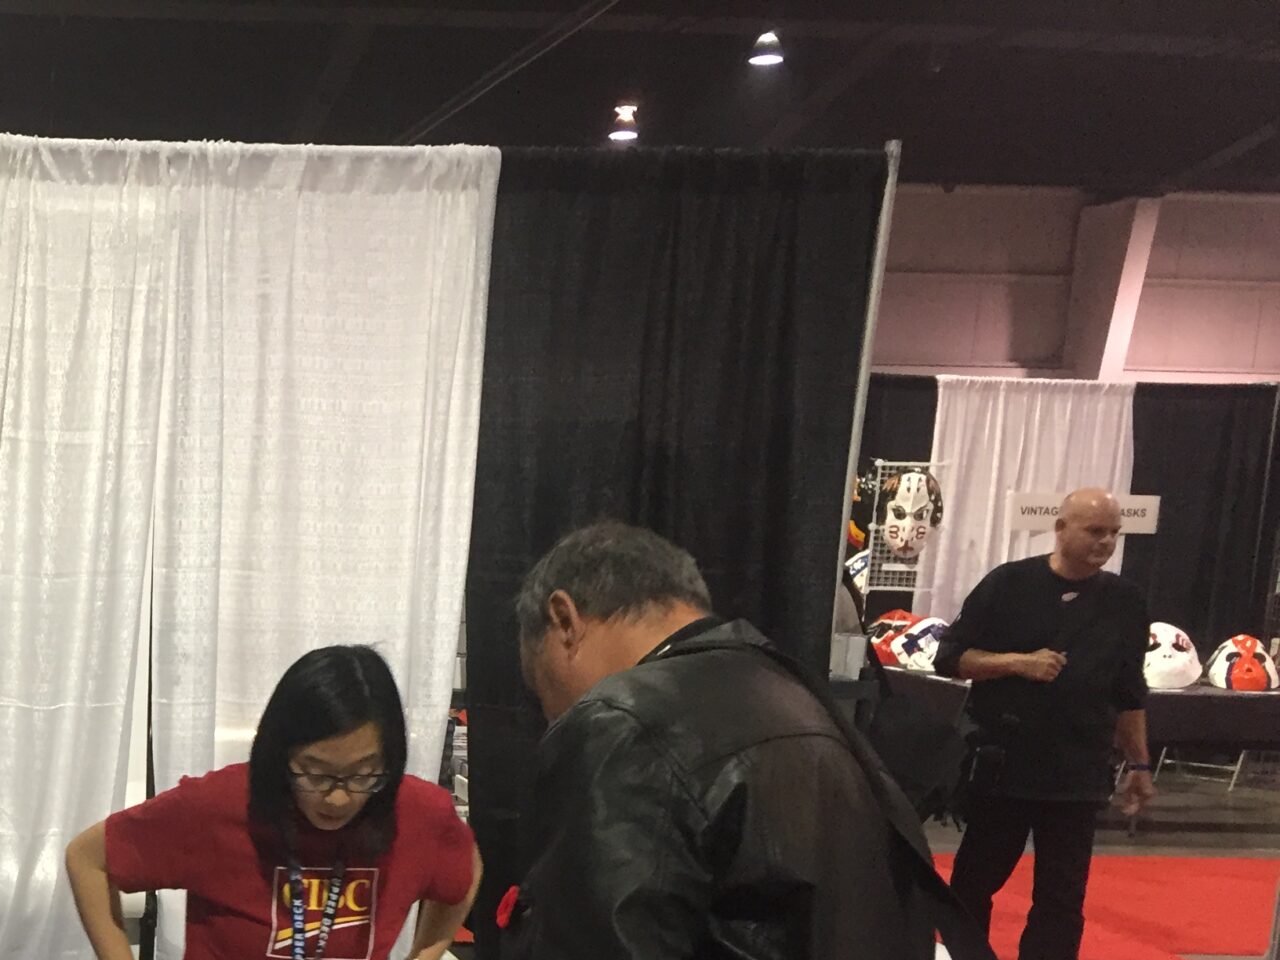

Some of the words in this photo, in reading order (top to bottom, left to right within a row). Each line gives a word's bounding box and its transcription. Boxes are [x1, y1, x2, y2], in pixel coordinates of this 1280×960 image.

[1020, 506, 1059, 516] VINTAG
[1120, 508, 1147, 517] ASKS
[292, 899, 305, 929] DECK
